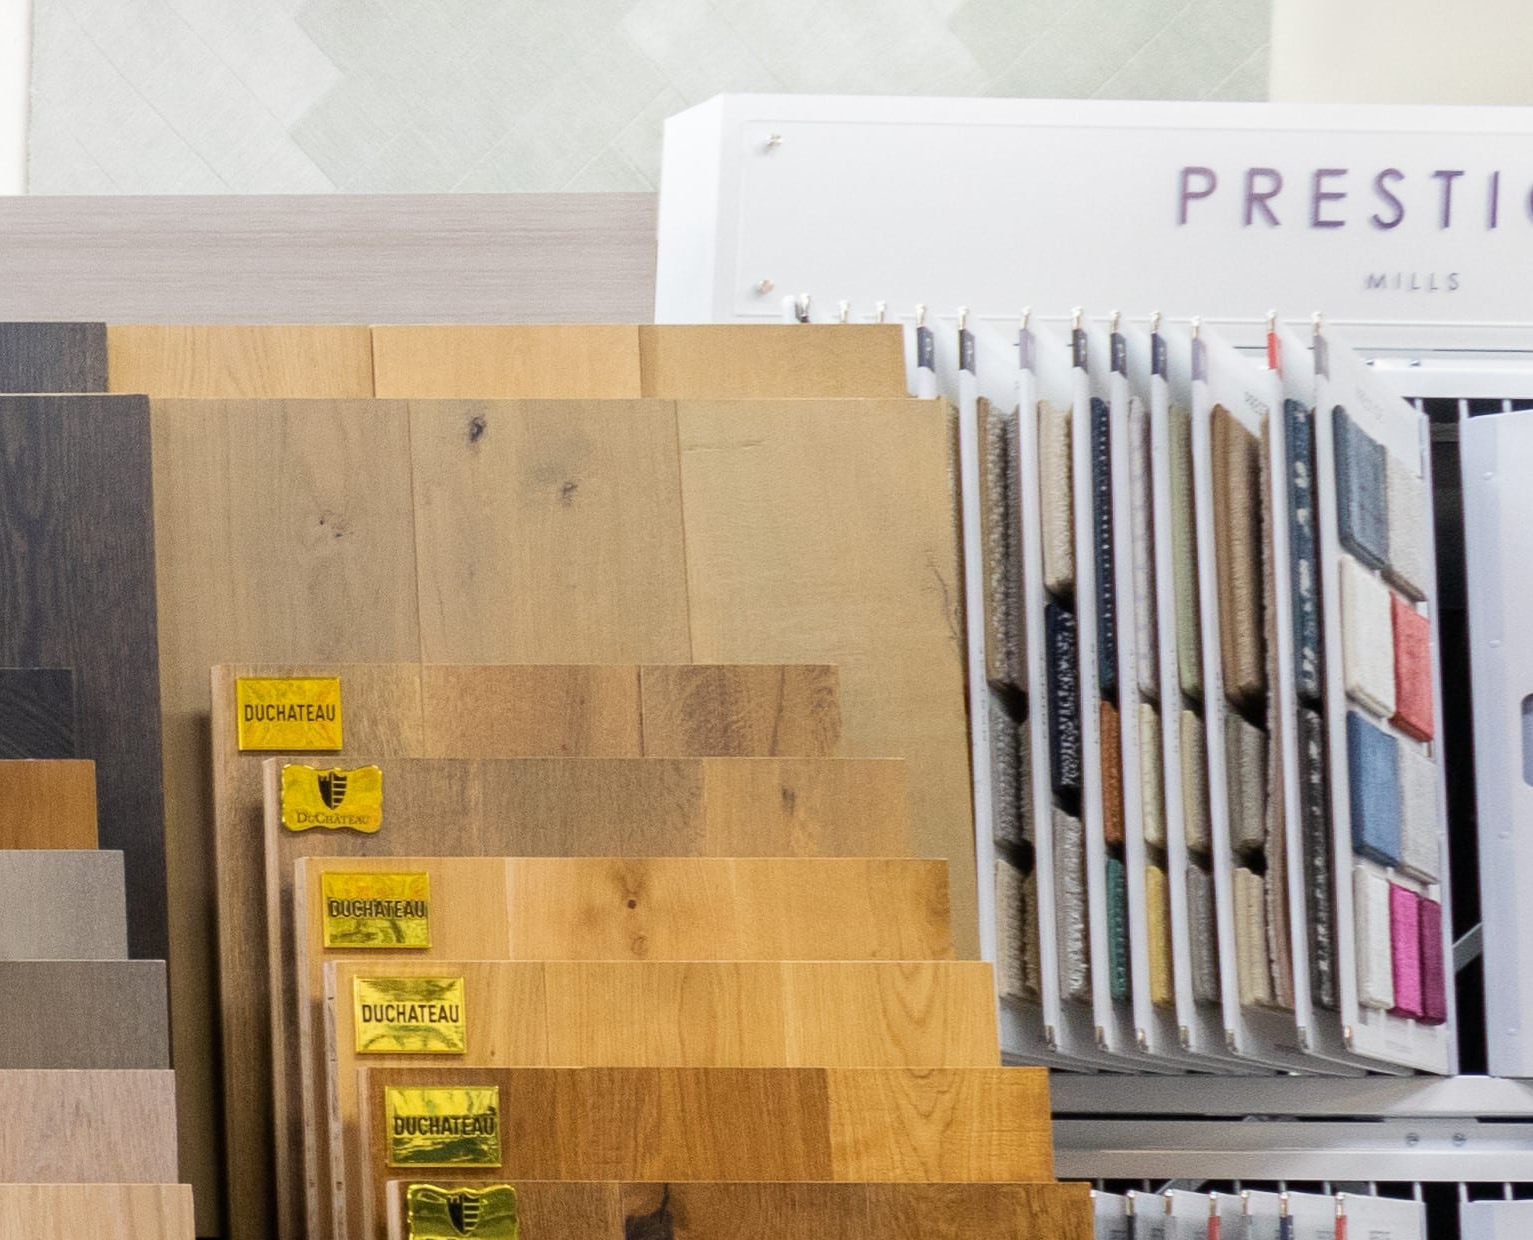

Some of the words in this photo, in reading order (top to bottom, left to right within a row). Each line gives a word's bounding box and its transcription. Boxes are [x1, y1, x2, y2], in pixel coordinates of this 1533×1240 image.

[1177, 166, 1533, 230] PRESTI
[1366, 271, 1460, 291] MILLS
[244, 704, 336, 722] DUCHATEAU
[328, 900, 426, 918] DUCHATEAU
[362, 1003, 460, 1023] DUCHATEAU
[394, 1116, 495, 1136] DUCHATEAU
